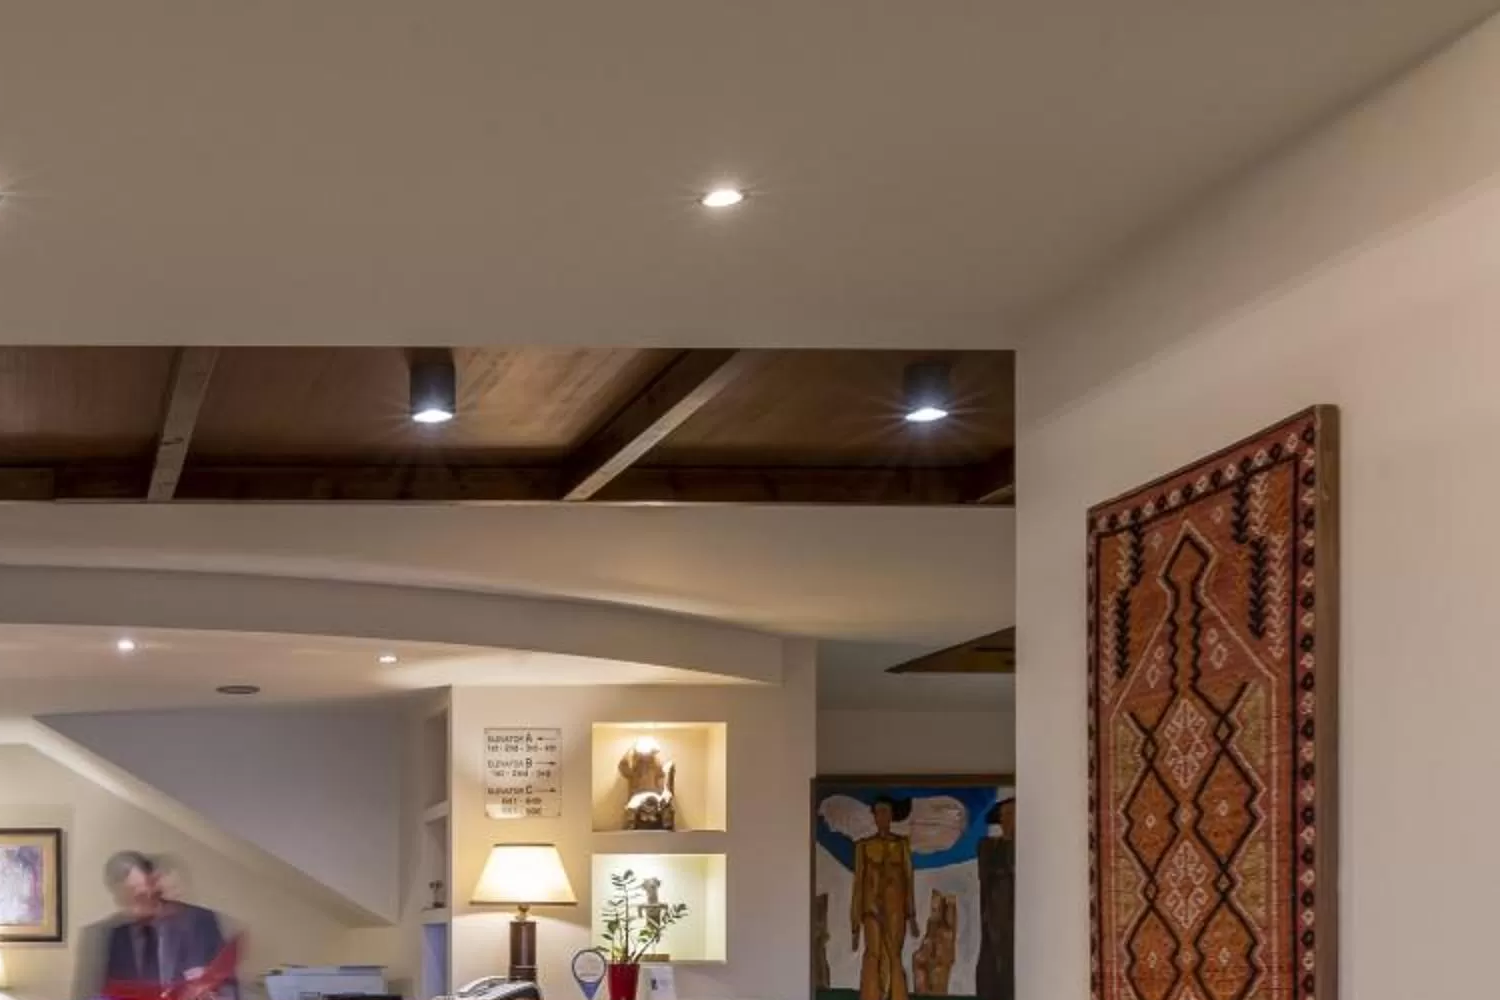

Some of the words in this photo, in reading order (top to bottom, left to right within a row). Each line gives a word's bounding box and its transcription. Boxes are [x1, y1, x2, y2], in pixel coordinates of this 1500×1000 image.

[526, 732, 533, 743] A
[488, 760, 524, 769] ELEVATOR
[526, 758, 533, 768] B
[526, 785, 532, 794] C
